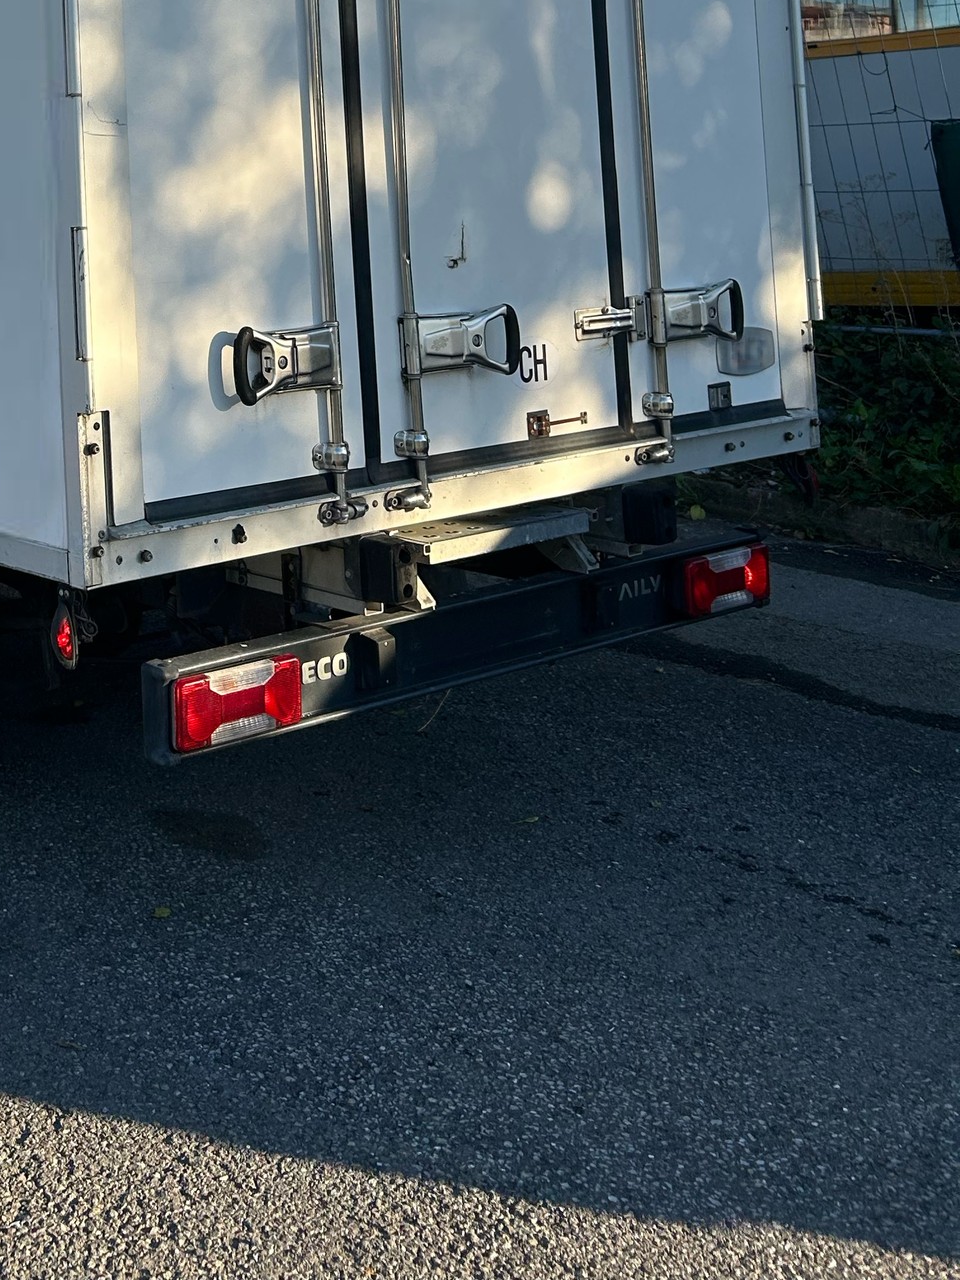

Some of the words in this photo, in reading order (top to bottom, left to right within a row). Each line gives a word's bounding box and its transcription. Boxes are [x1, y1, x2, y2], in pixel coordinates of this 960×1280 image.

[520, 344, 548, 383] CH
[618, 574, 662, 602] AILY
[301, 652, 349, 685] ECO
